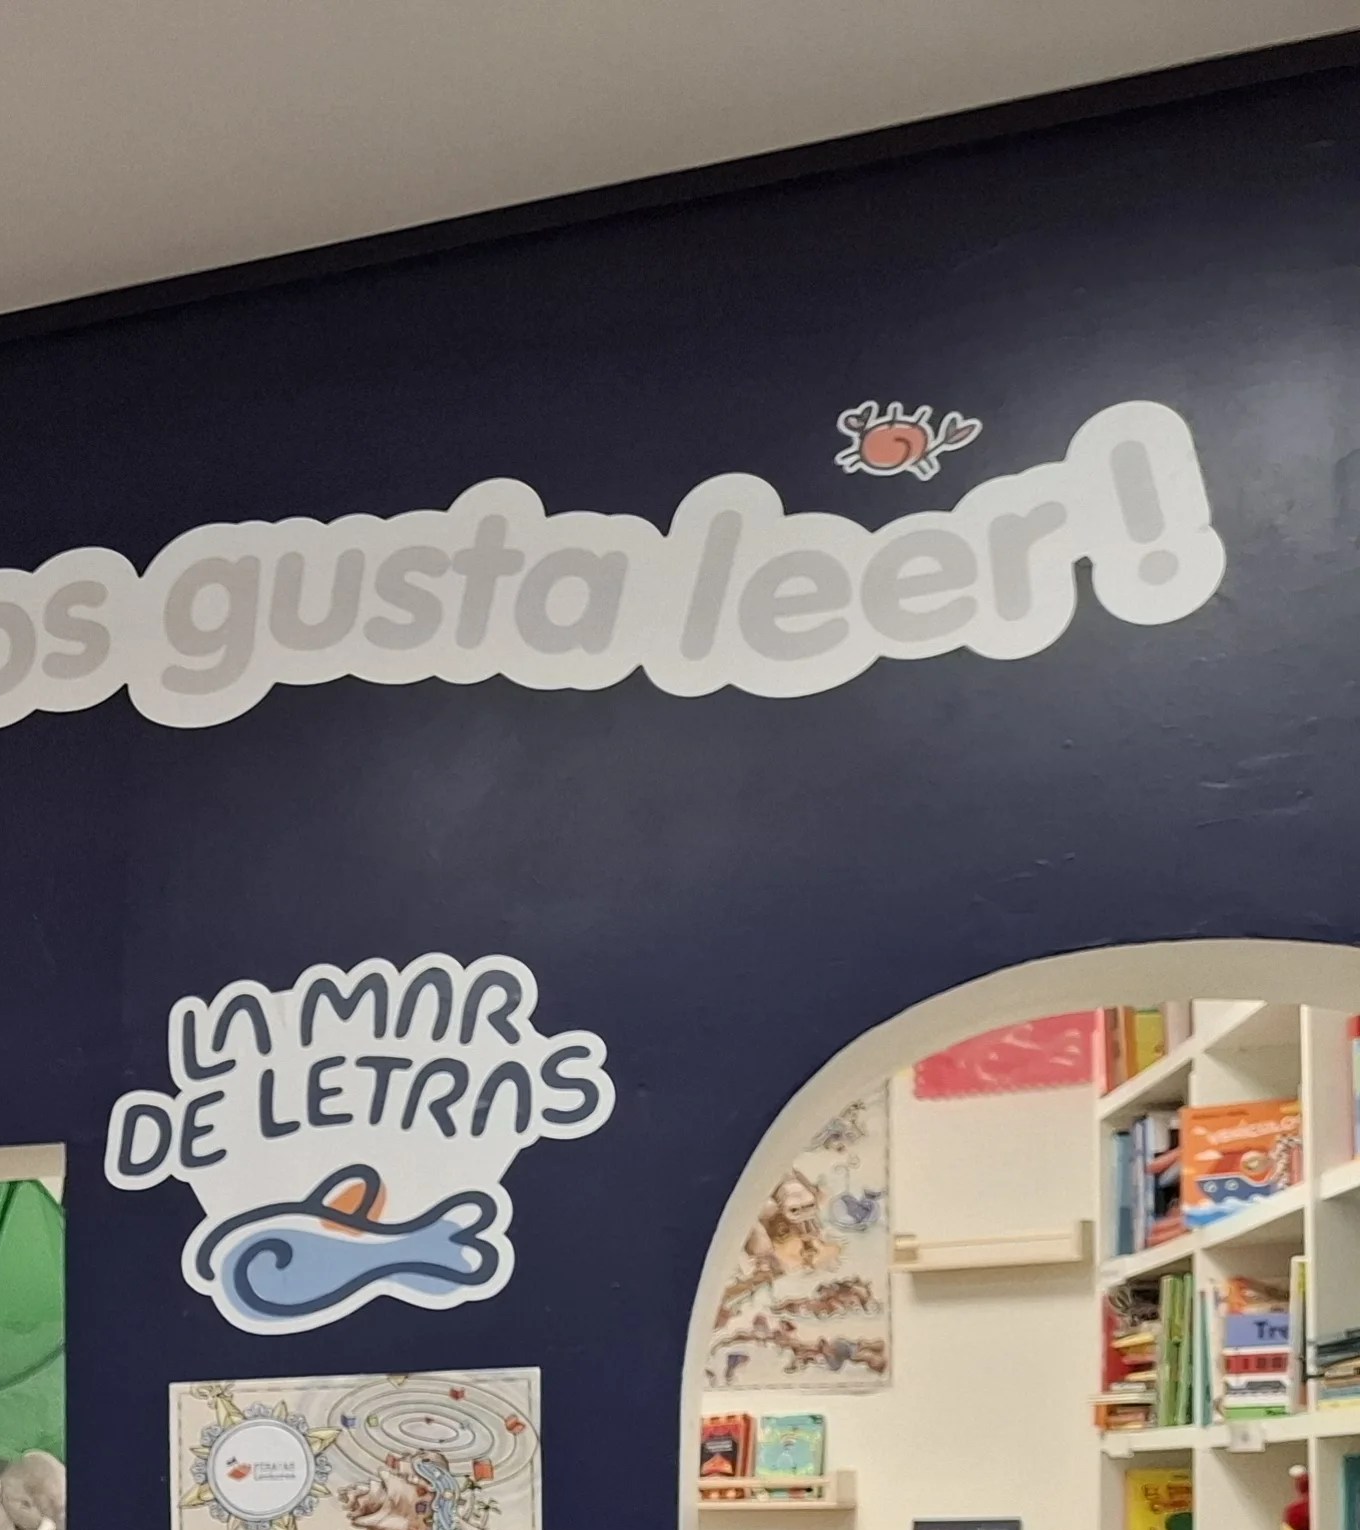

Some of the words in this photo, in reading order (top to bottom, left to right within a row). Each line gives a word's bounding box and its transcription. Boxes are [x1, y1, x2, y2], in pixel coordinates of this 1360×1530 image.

[160, 513, 628, 697] gusta
[678, 437, 1186, 664] leer!
[182, 992, 273, 1081] LA
[299, 966, 524, 1048] MAR
[116, 1090, 228, 1177] DE
[259, 1044, 602, 1140] LETRAS
